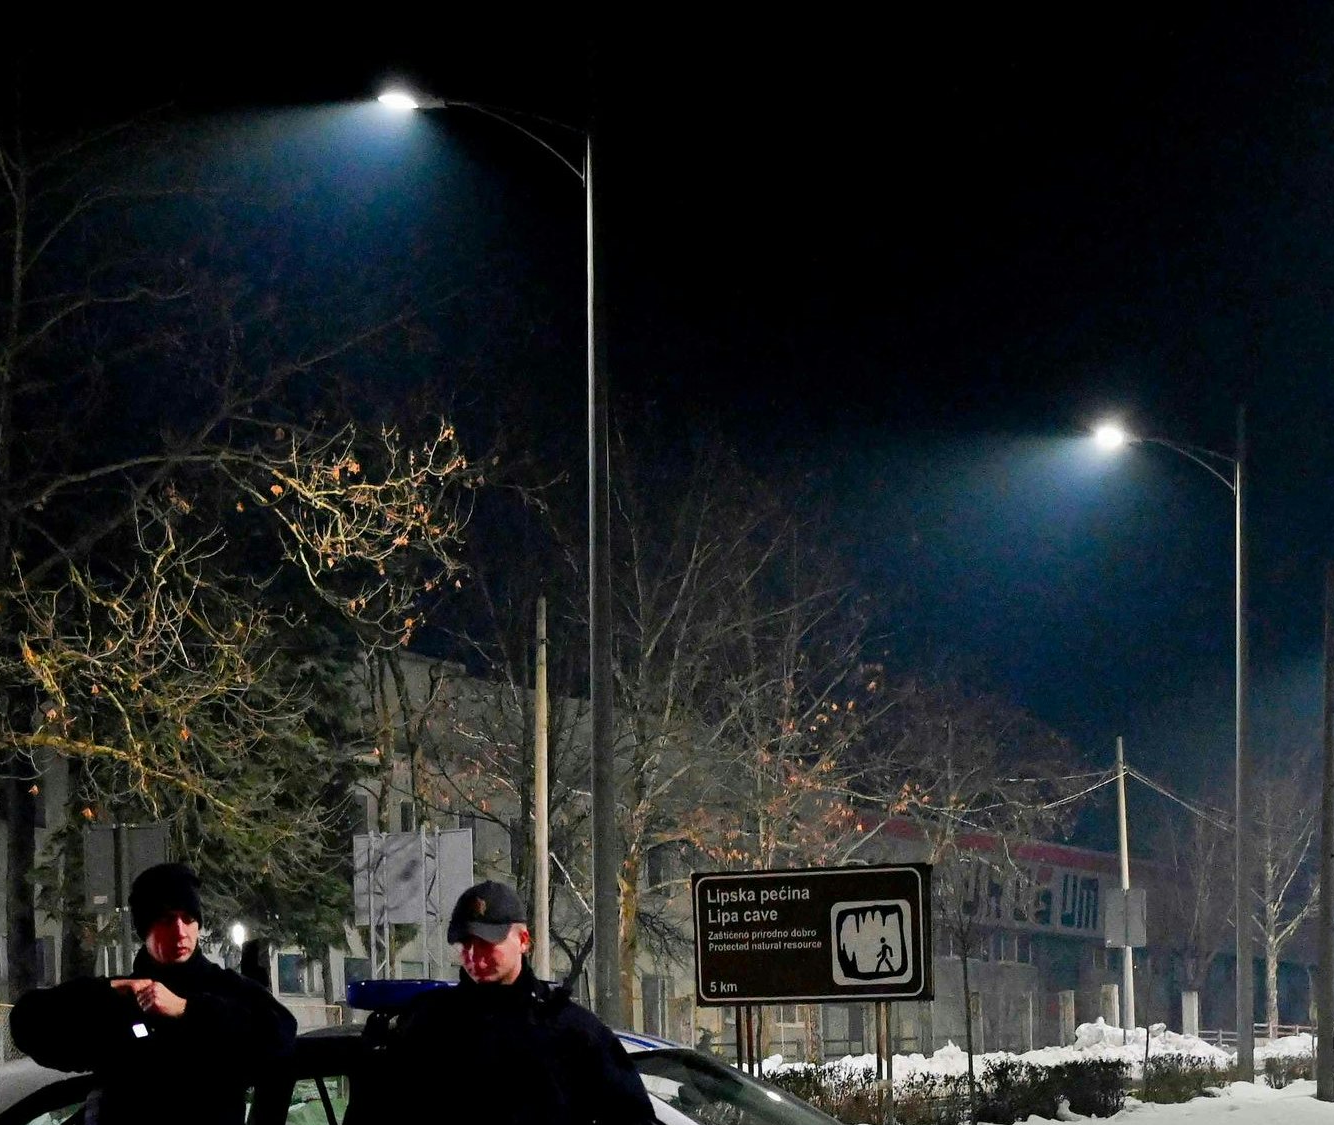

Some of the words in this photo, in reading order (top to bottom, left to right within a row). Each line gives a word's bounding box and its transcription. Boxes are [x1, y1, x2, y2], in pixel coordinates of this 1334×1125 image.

[707, 888, 756, 906] Lipska
[760, 886, 810, 904] pećina
[708, 909, 739, 926] Lipa
[743, 909, 778, 922] cave
[751, 929, 788, 940] prirodno
[790, 928, 817, 937] dobro
[708, 942, 749, 952] Protected
[751, 941, 782, 951] natural
[783, 940, 822, 949] resource
[710, 982, 717, 993] 5
[720, 982, 738, 993] km
